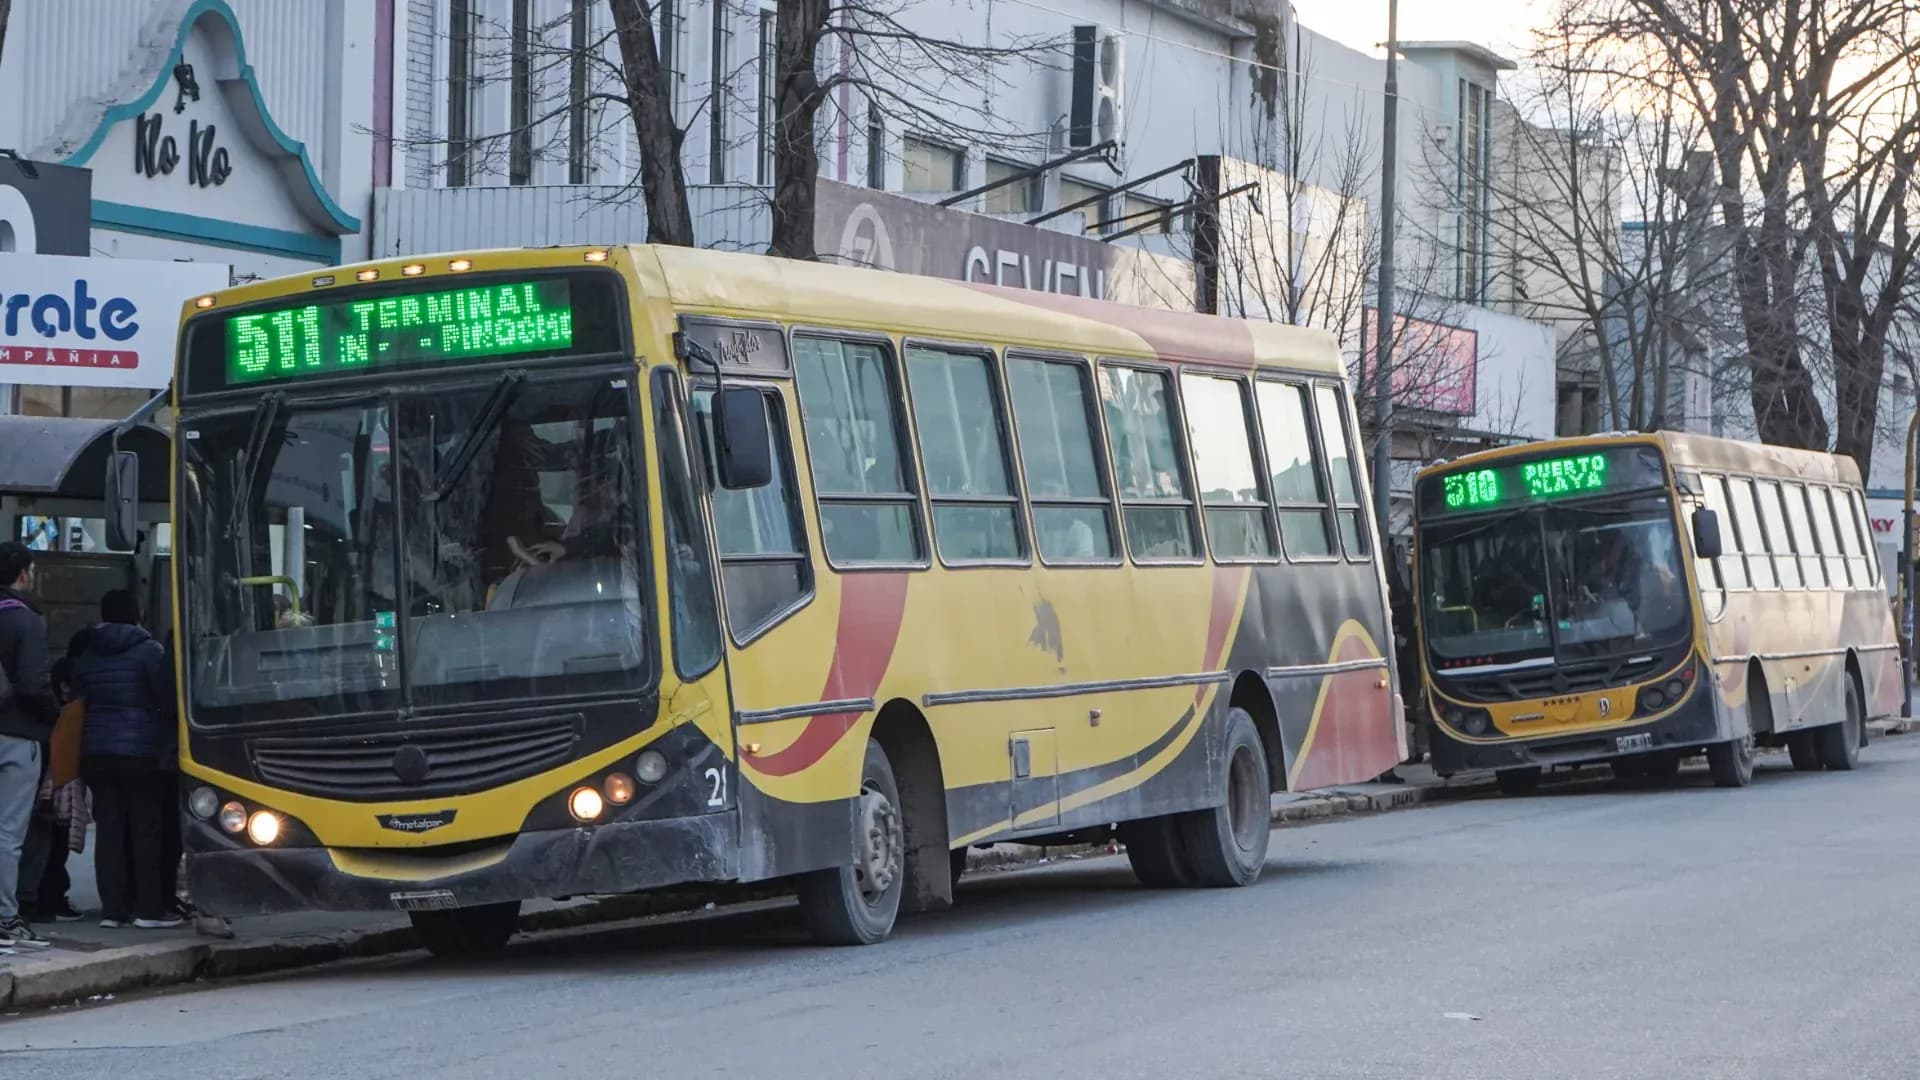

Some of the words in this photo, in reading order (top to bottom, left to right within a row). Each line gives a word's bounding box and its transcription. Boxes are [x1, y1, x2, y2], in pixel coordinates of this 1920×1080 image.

[0, 279, 139, 341] rate
[353, 285, 540, 331] TERMINAL
[237, 304, 321, 372] 511
[1525, 455, 1604, 481] PUERTO
